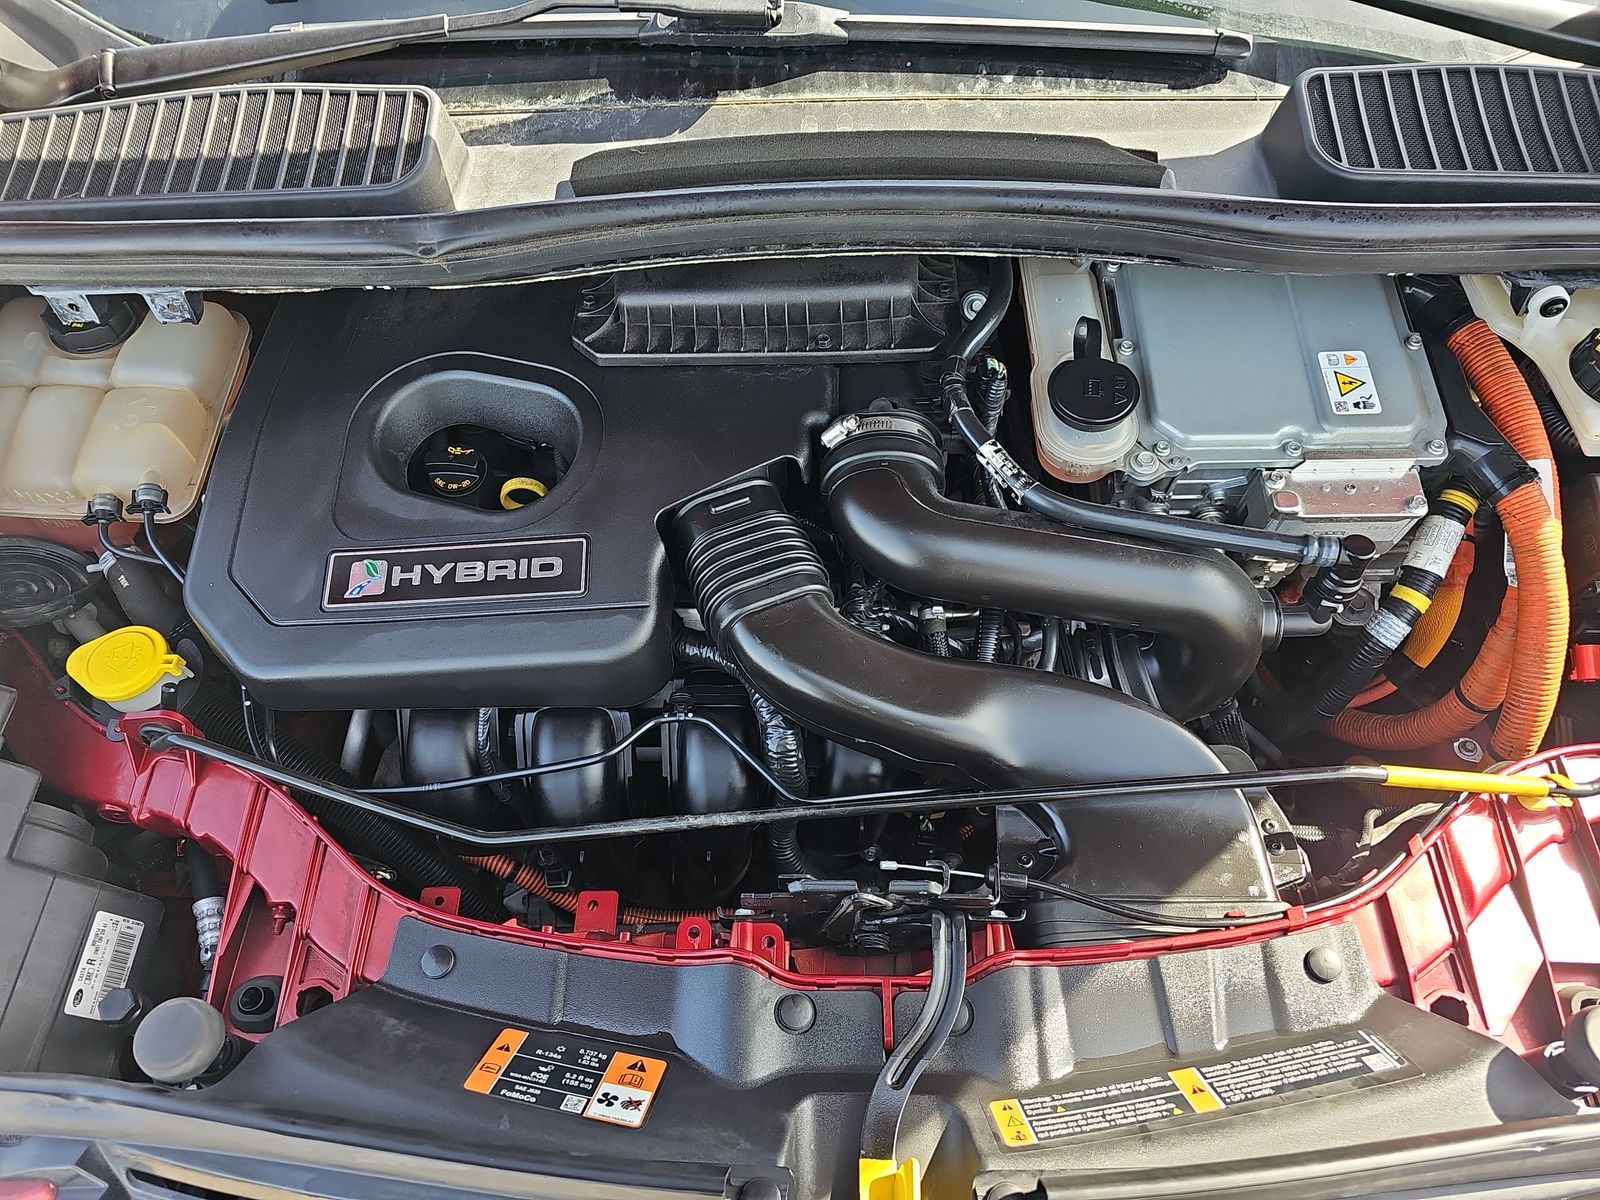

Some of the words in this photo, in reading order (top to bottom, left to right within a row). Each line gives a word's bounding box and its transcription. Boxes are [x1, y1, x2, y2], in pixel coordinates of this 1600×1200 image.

[434, 477, 446, 488] SAE
[448, 479, 471, 490] 0W-20
[391, 556, 563, 587] HYBRID
[86, 958, 96, 966] R
[535, 1048, 562, 1060] R-134a
[579, 1048, 598, 1056] 0.737
[598, 1052, 608, 1060] kg
[530, 1071, 550, 1080] POE
[564, 1072, 578, 1080] 5.2
[514, 1084, 527, 1092] SAE
[562, 1078, 578, 1087] (155
[579, 1082, 592, 1090] cc)
[500, 1089, 536, 1102] FoMoCo
